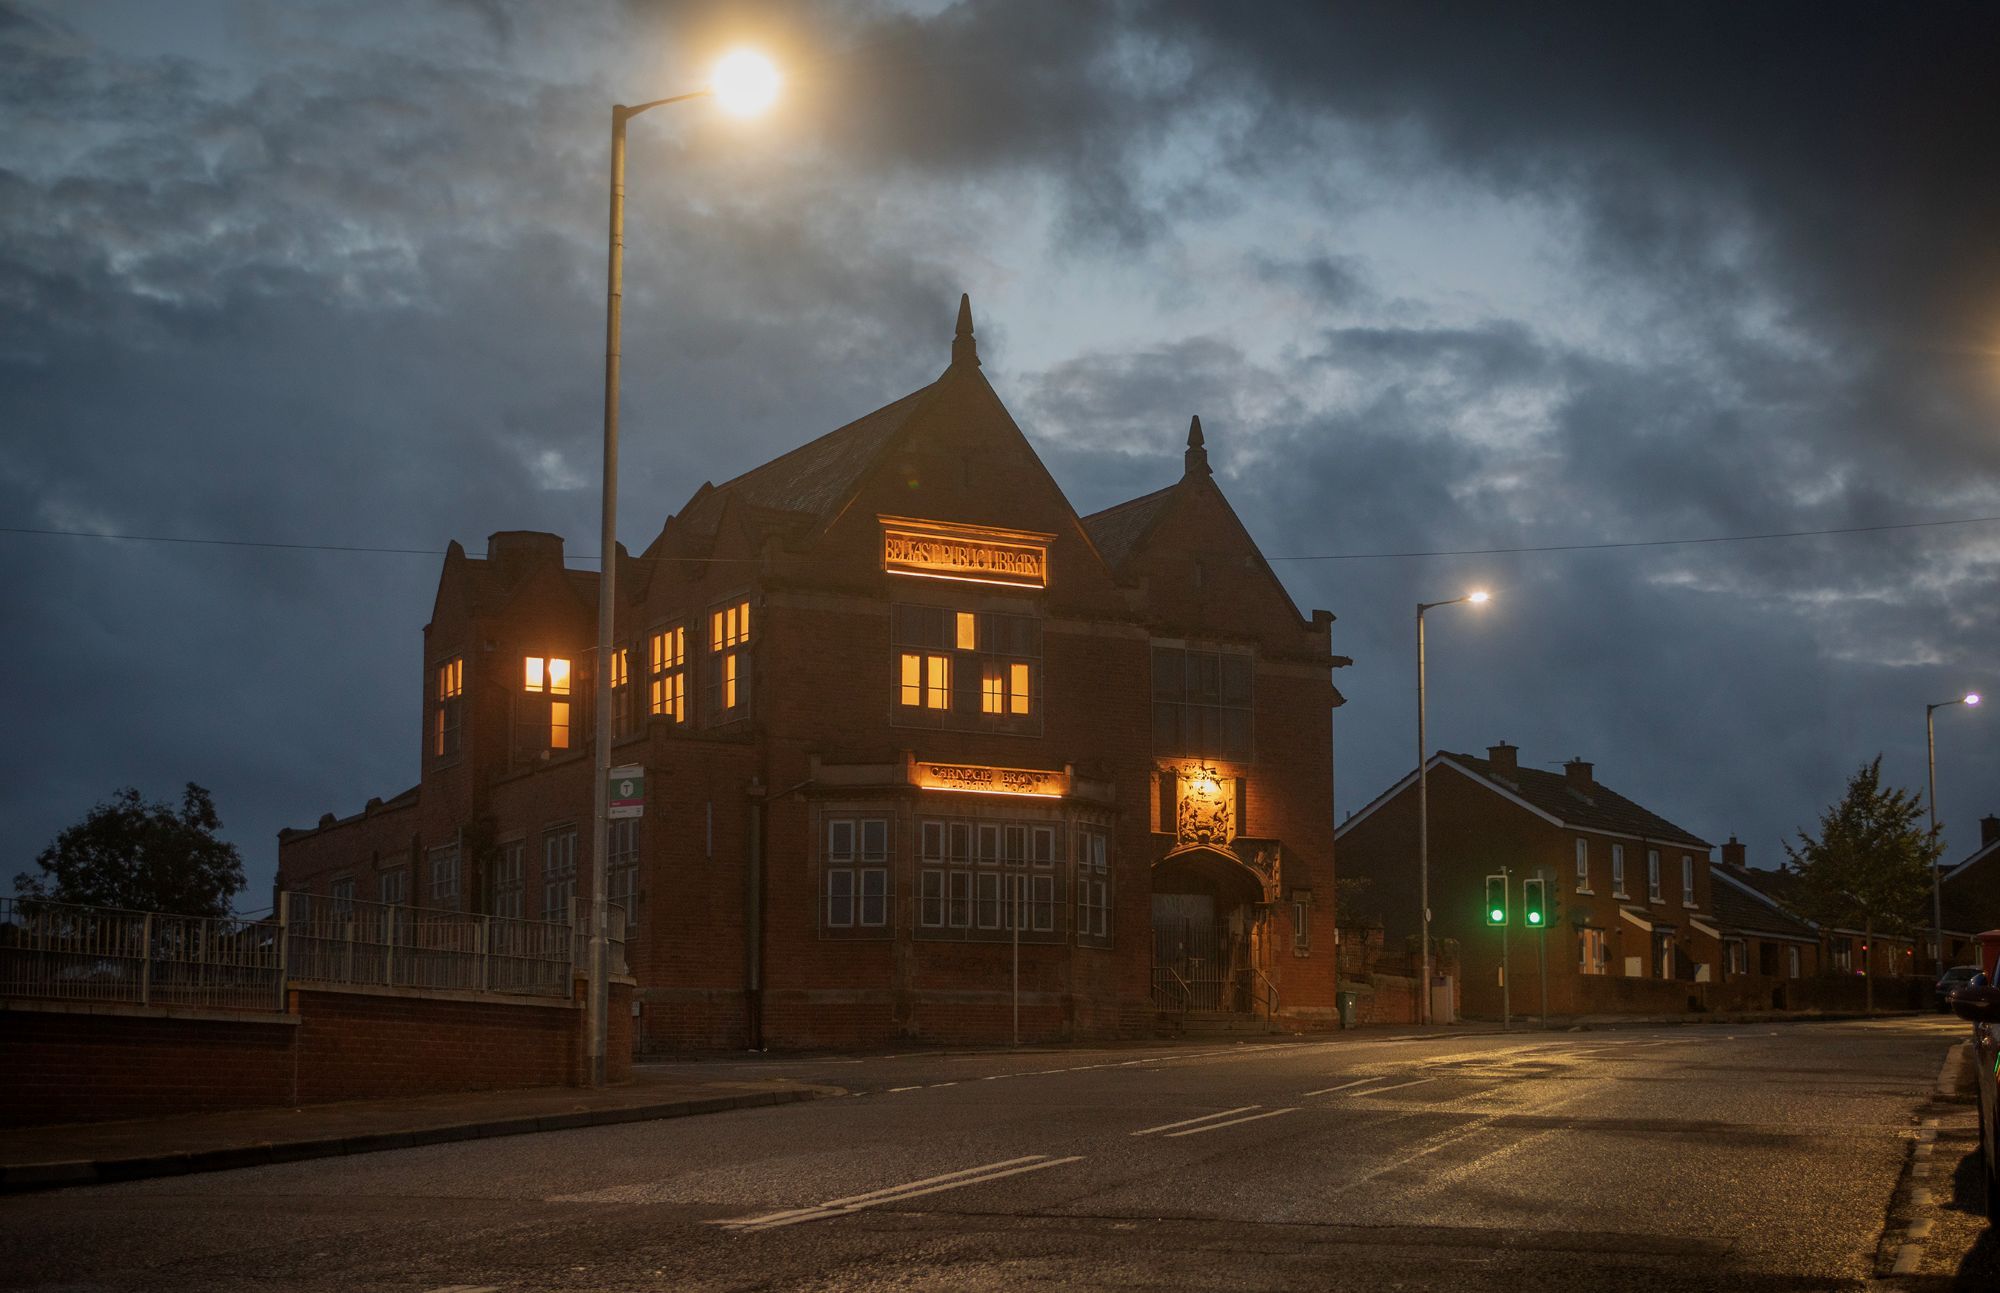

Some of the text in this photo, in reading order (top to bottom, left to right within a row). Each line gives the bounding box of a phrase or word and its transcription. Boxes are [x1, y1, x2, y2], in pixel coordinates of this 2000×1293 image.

[886, 538, 1042, 575] BELFAST PUBLIC LIBRARY
[930, 767, 1050, 784] CARNEGIE BRANCH
